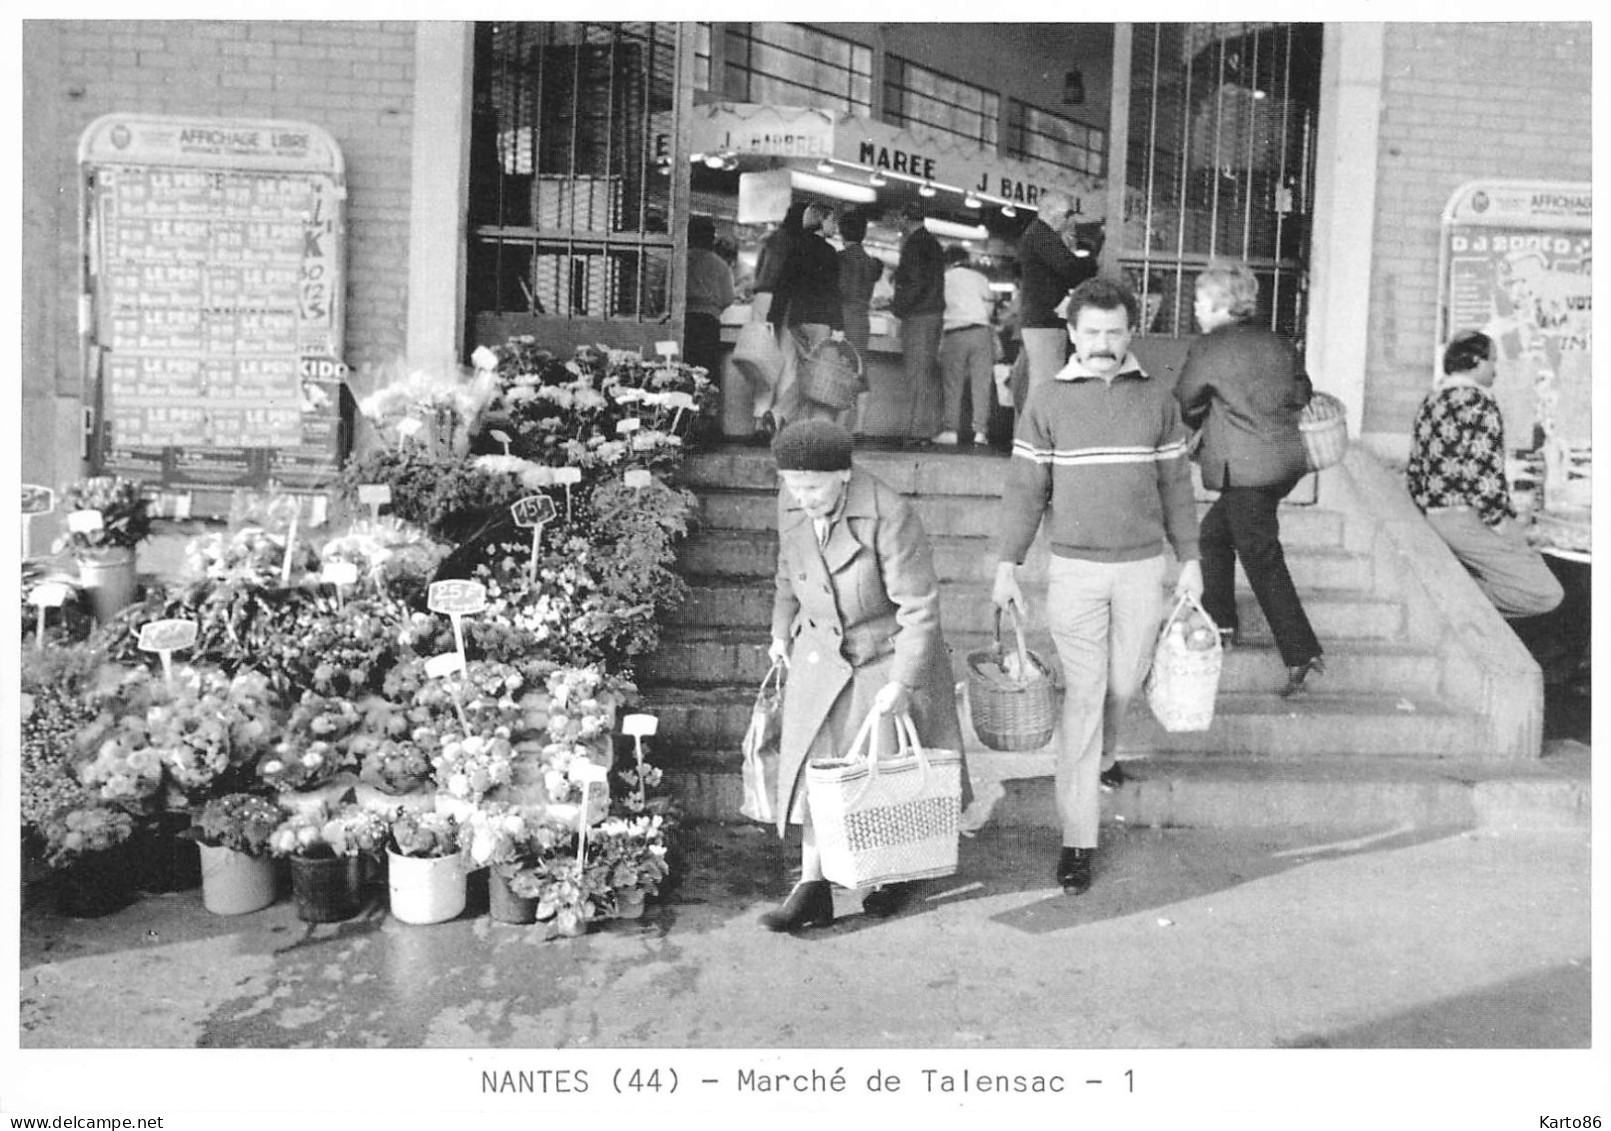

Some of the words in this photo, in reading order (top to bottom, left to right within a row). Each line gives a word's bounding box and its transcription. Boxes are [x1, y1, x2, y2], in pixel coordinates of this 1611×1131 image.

[181, 129, 259, 146] AFFICHAGE
[859, 141, 936, 180] MAREE
[976, 173, 988, 192] J
